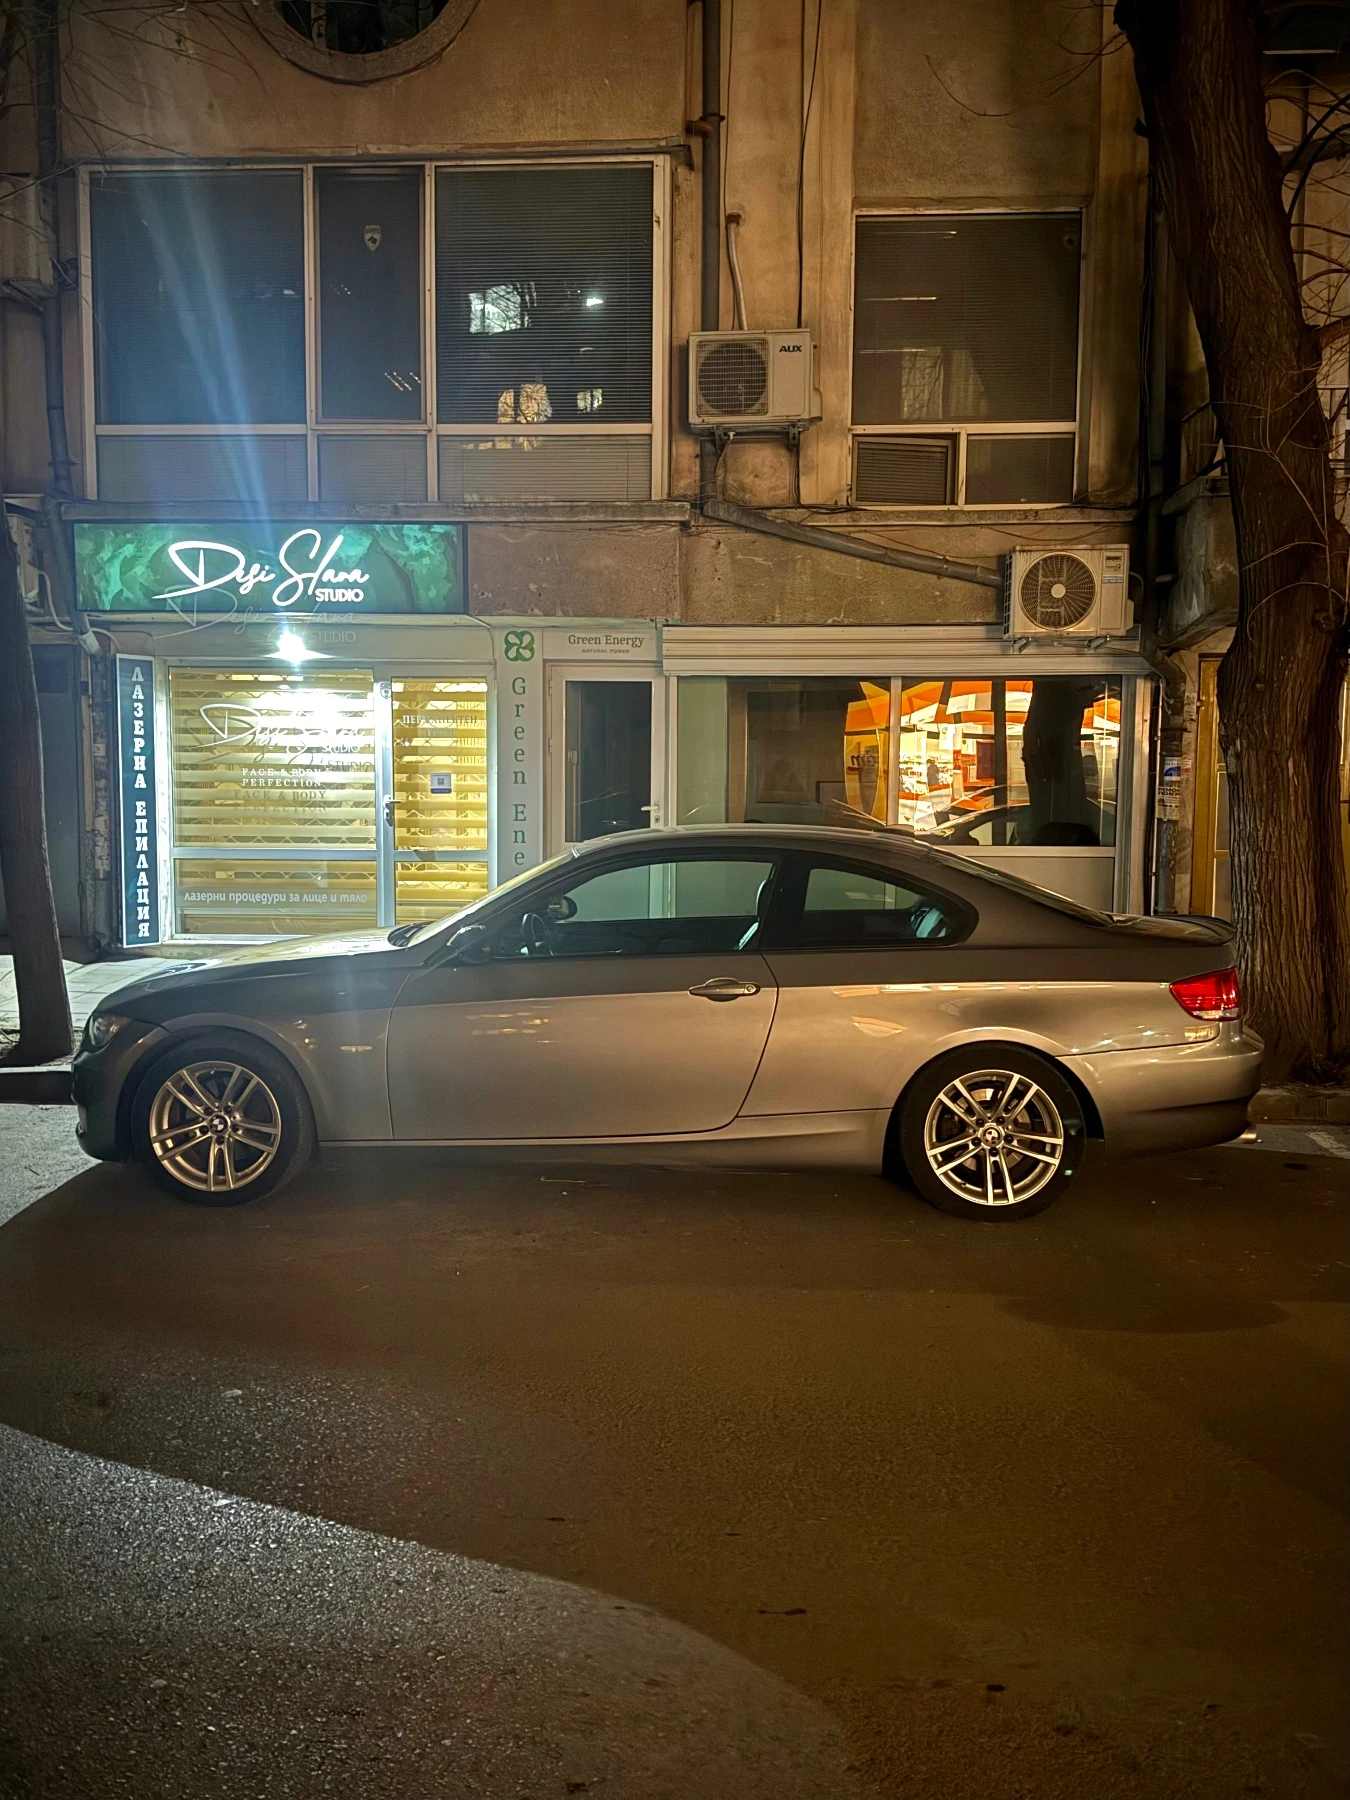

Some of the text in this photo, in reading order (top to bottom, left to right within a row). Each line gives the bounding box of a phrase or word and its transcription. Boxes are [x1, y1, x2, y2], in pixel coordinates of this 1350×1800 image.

[779, 344, 802, 353] AUX
[315, 588, 364, 602] STUDIO
[568, 634, 645, 648] Green Energy
[131, 666, 147, 789] ЛАЗЕРНА
[511, 677, 527, 785] Green
[241, 768, 275, 776] FACE
[241, 778, 321, 787] PERFECTION
[512, 803, 527, 876] Ene
[135, 801, 150, 938] ЕПИЛАЦИЯ
[184, 892, 367, 905] лазерни процедури за лице и тяло
